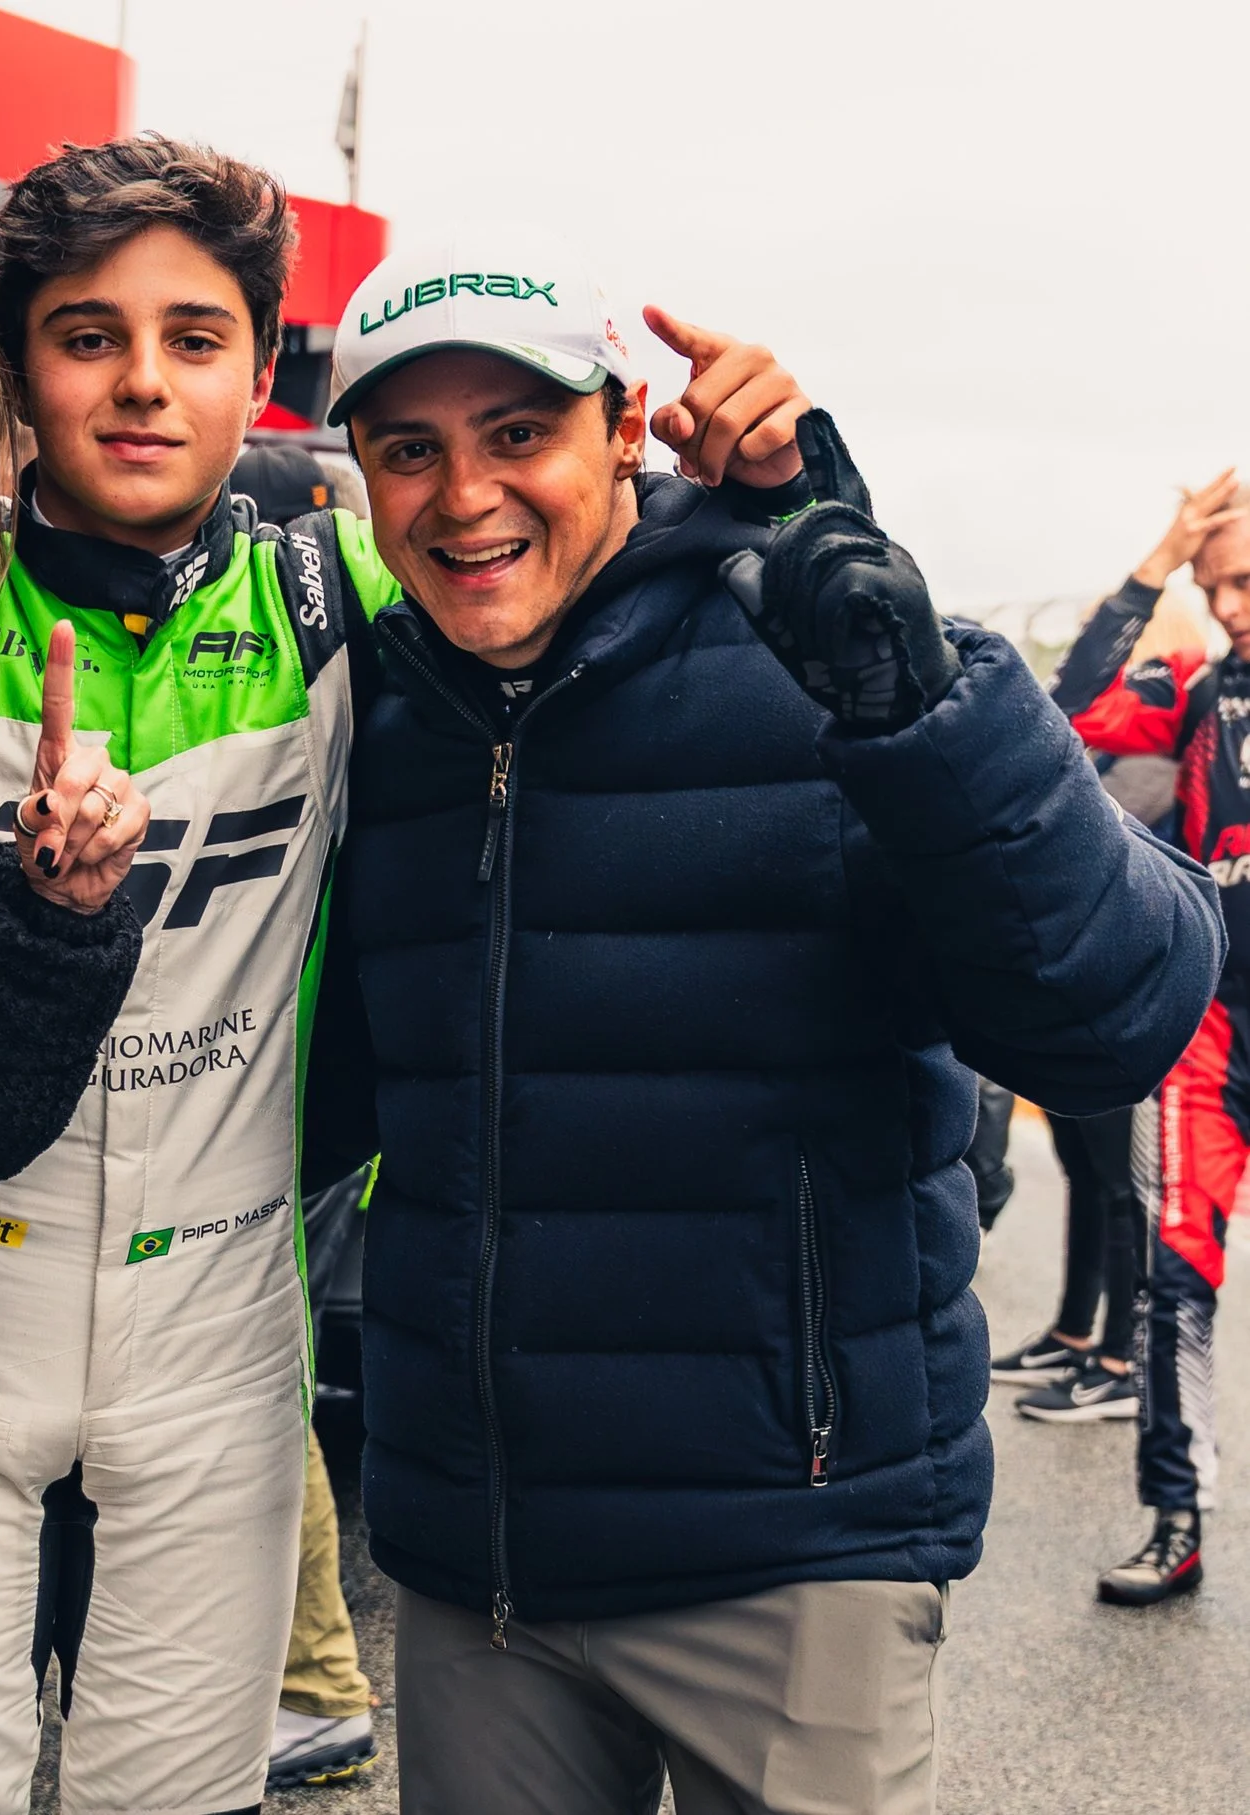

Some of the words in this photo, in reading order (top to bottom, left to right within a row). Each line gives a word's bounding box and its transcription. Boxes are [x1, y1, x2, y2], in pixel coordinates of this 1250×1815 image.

[290, 532, 328, 630] Sabelt
[183, 666, 271, 679] MOTORSPOR
[88, 1044, 249, 1092] URADORA
[181, 1219, 228, 1243] PIPO
[234, 1194, 289, 1229] MASSA
